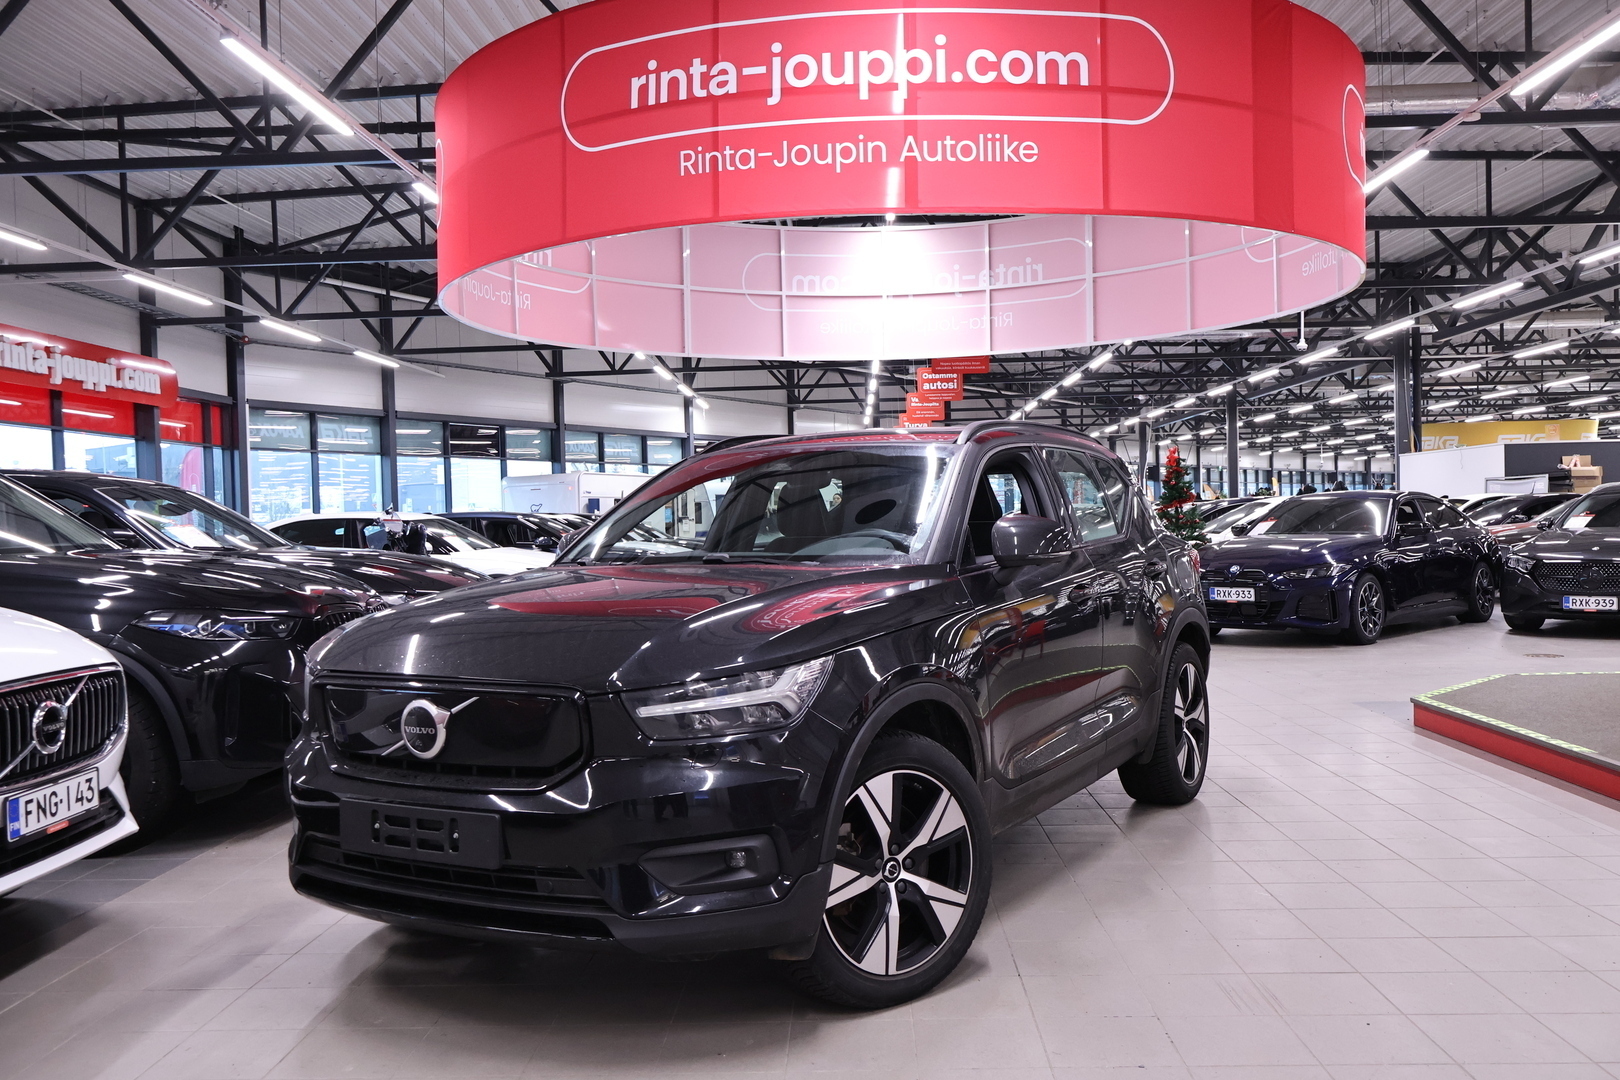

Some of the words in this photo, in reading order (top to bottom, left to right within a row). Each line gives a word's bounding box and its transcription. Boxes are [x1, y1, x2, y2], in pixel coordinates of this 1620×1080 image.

[630, 34, 1089, 109] rinta-jouppi.com
[680, 135, 887, 176] Rinta-Joupin
[899, 133, 1039, 163] Autoliike
[922, 379, 957, 389] autosi
[1216, 590, 1253, 599] RXK-933
[1571, 598, 1615, 607] RXK-939
[404, 726, 436, 734] VOLVO
[25, 777, 94, 828] FNG-143
